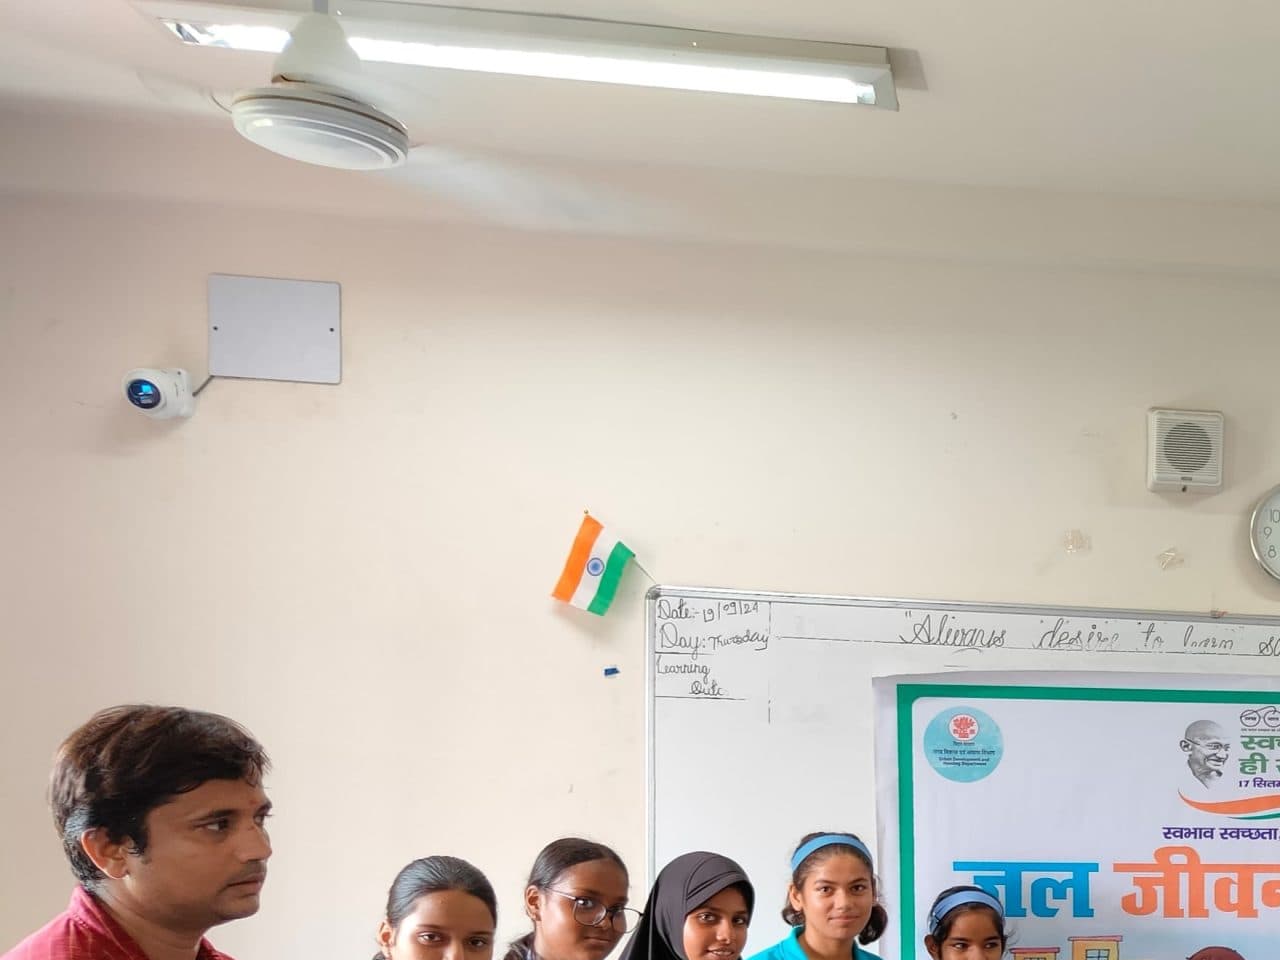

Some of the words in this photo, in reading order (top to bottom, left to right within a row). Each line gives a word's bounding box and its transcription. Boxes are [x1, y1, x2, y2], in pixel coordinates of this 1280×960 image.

[1269, 509, 1280, 523] 10
[1263, 526, 1272, 539] 9
[1268, 545, 1277, 558] 8
[1239, 753, 1269, 775] ही
[1239, 780, 1249, 788] 17
[1162, 827, 1215, 840] स्वभाव
